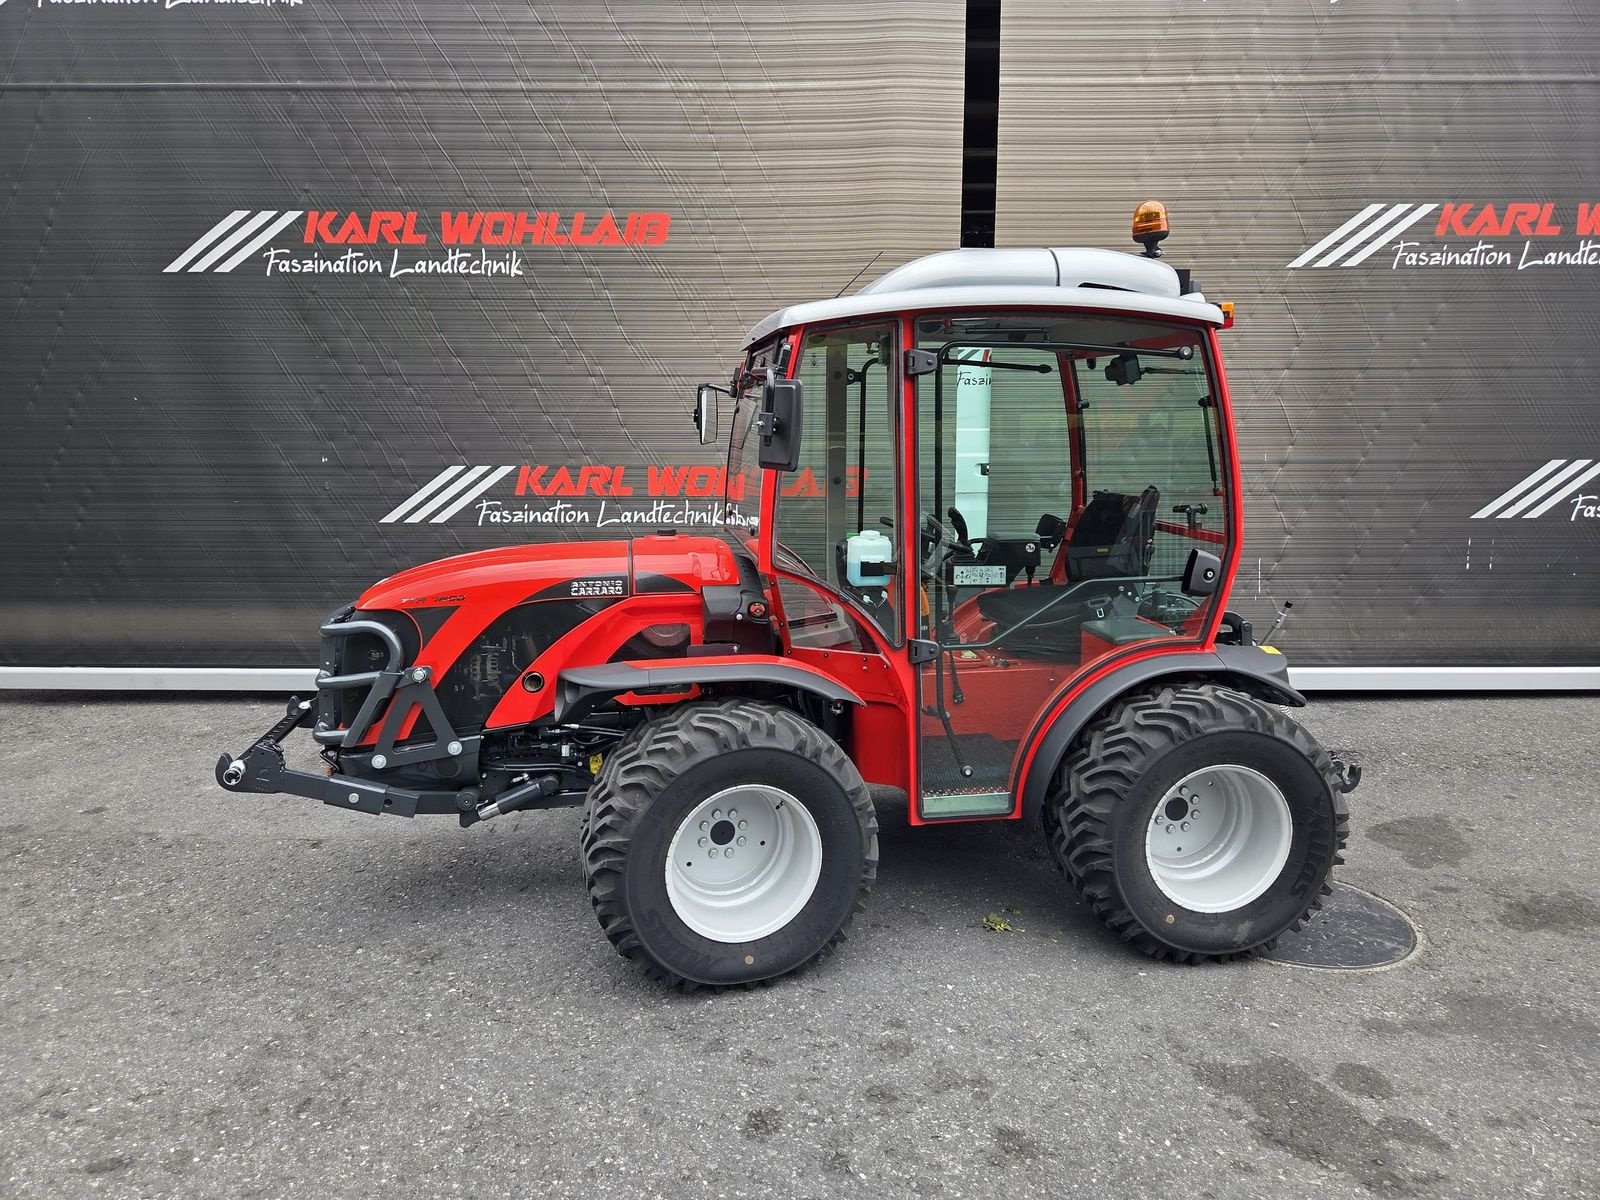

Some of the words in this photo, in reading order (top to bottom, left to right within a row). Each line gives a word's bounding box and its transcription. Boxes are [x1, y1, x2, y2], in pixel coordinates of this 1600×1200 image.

[304, 210, 427, 244] KARL
[1434, 202, 1561, 236] KARL
[263, 247, 382, 277] Faszination
[390, 248, 523, 278] Landtechnik
[1391, 240, 1511, 270] Faszination
[1517, 240, 1600, 271] Landte
[515, 465, 633, 497] KARL
[475, 499, 590, 527] Faszination
[597, 501, 725, 528] Landtechnik
[570, 579, 623, 588] ANTONIO
[570, 587, 623, 597] CARRARO
